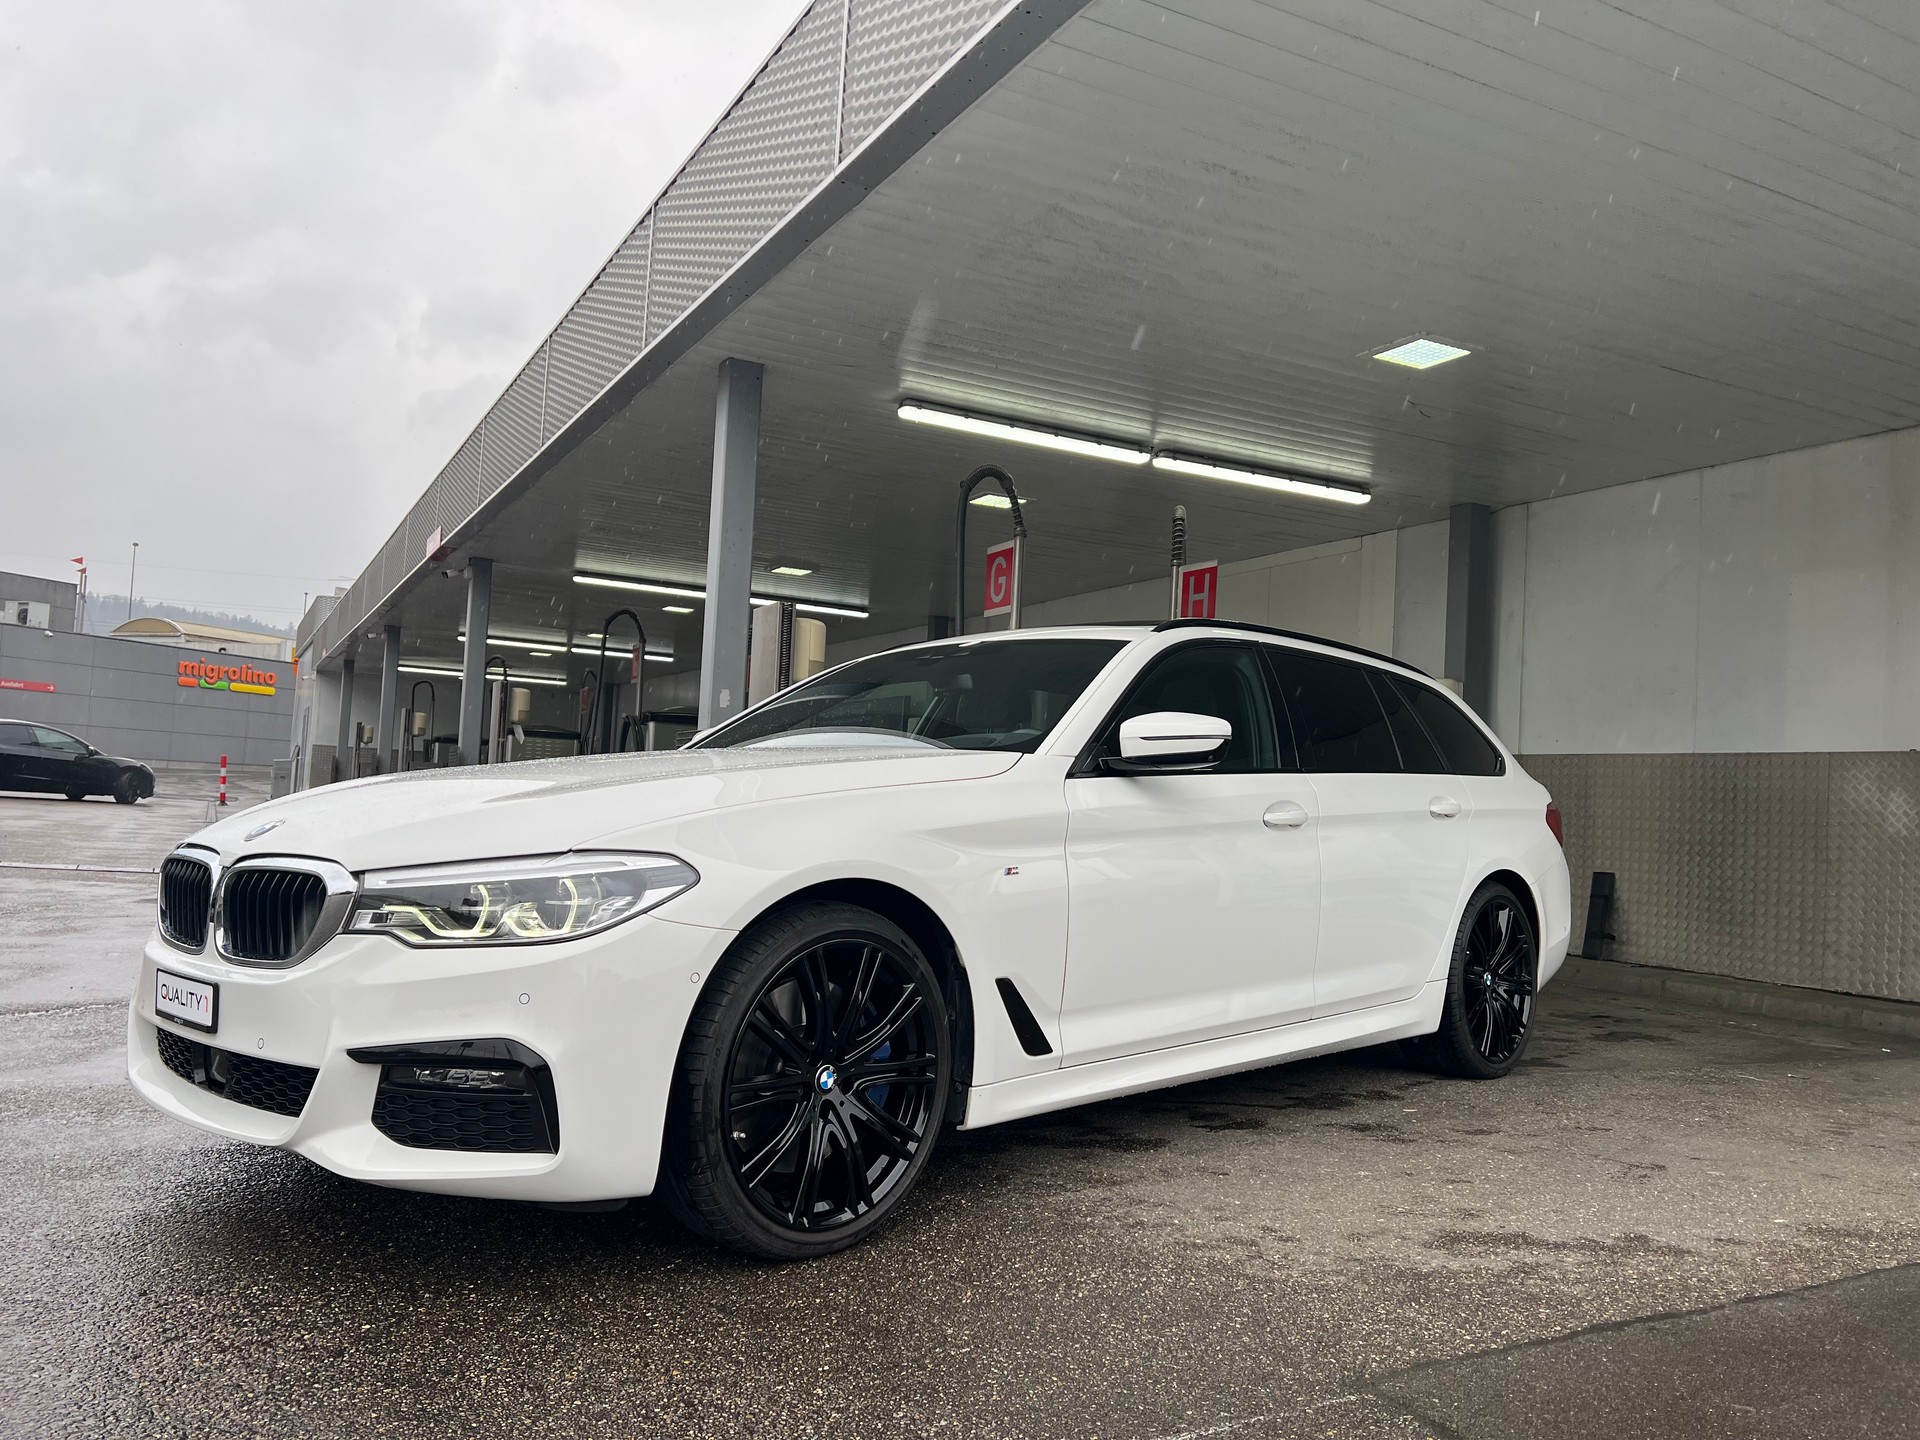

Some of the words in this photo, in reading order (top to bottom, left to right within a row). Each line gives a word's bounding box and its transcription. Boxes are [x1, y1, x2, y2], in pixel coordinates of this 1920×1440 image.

[990, 556, 1007, 604] G
[1187, 572, 1211, 618] H
[178, 657, 277, 686] migrolino
